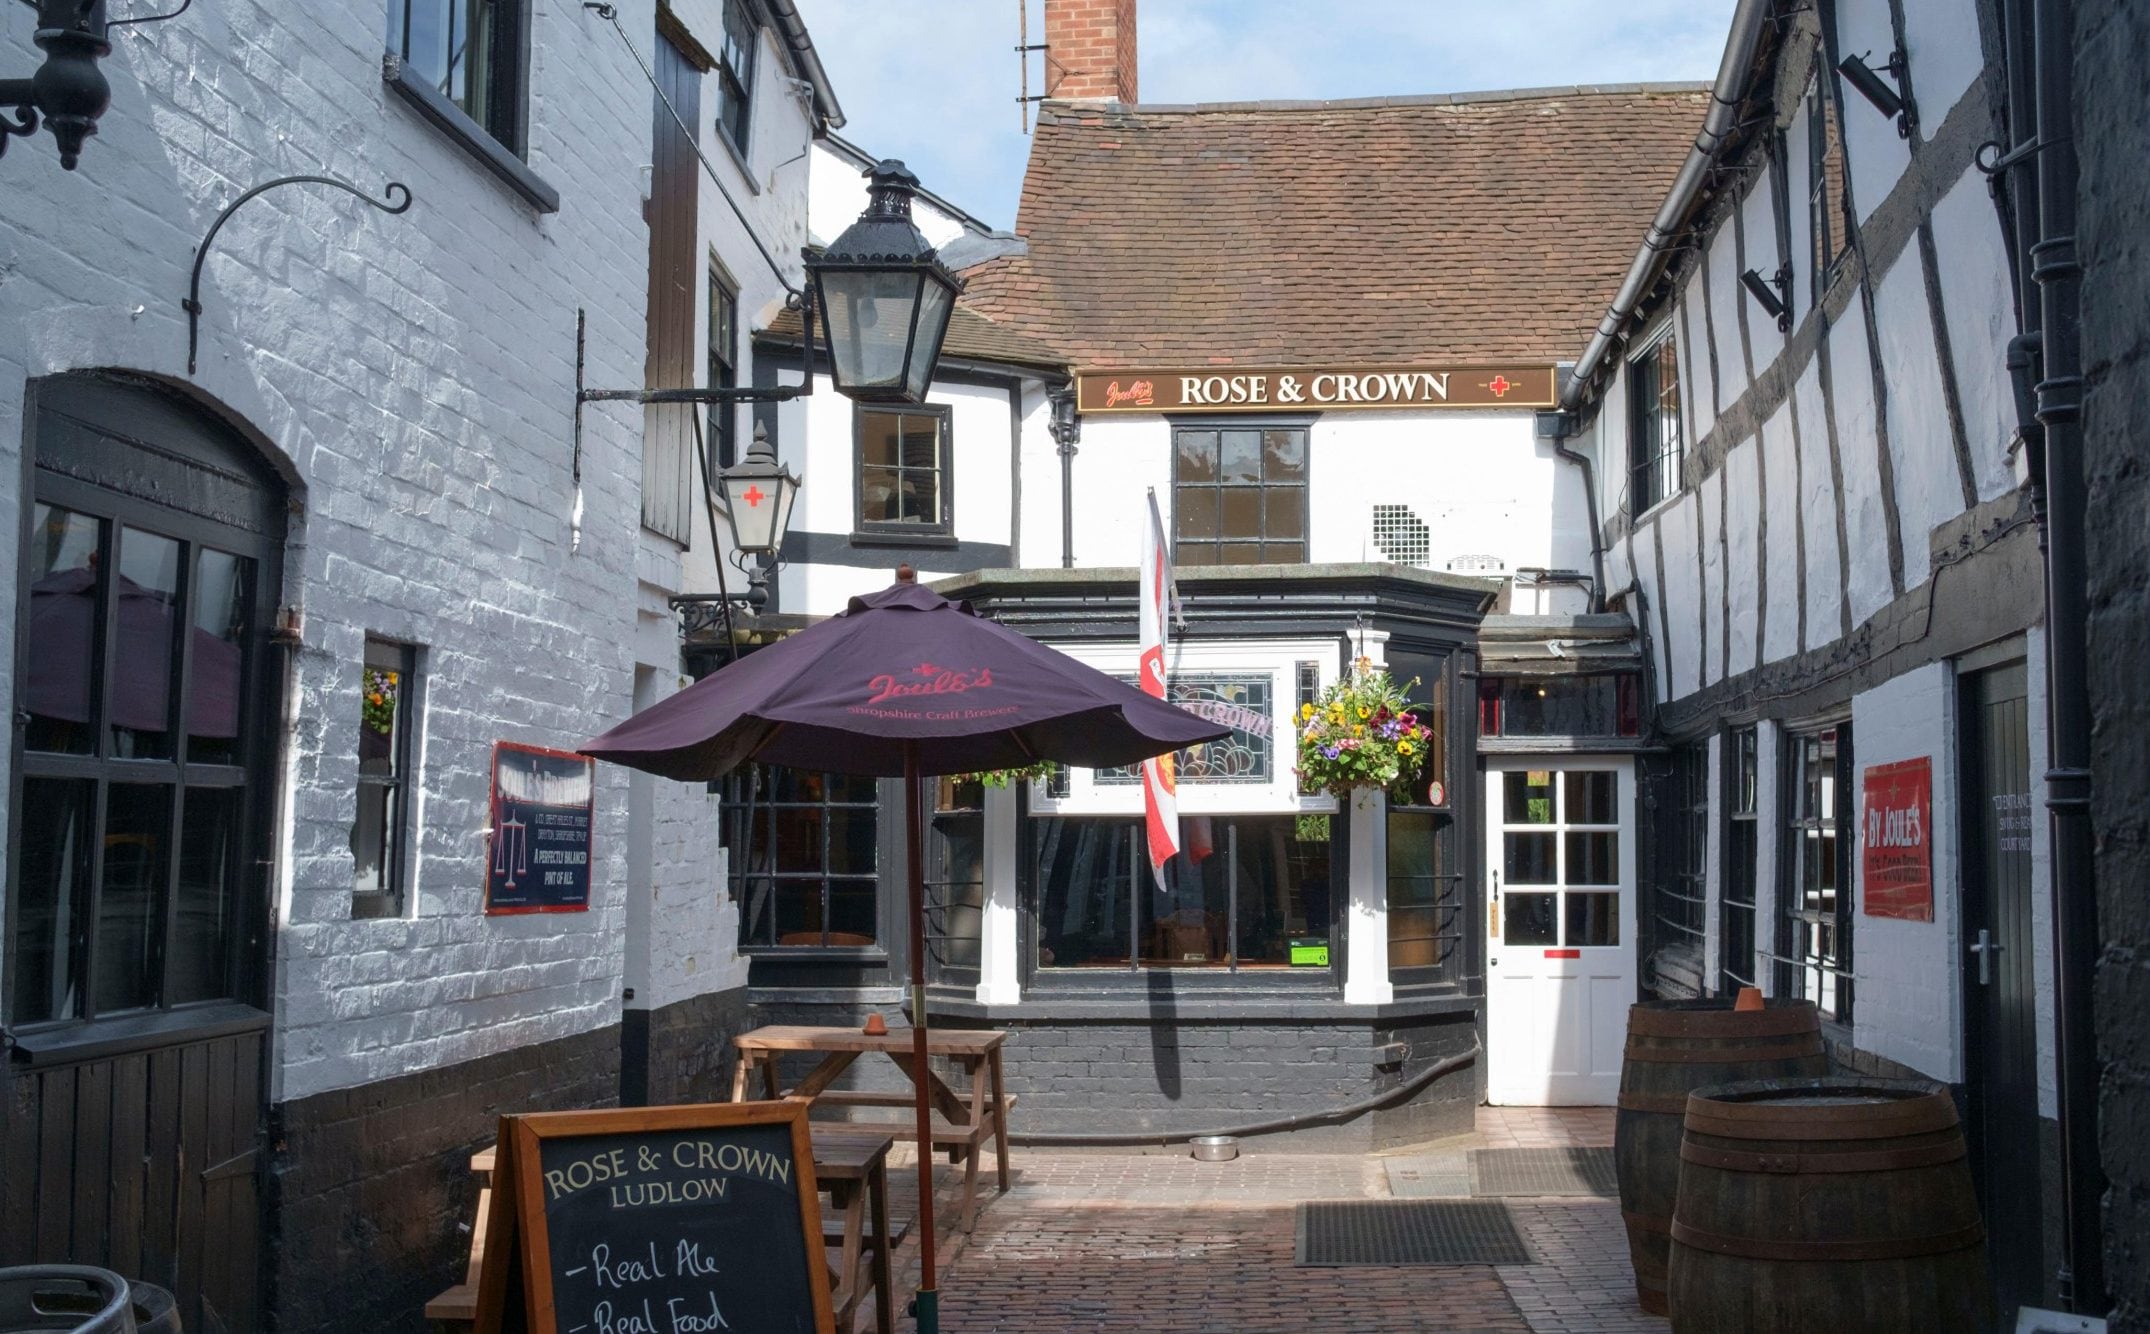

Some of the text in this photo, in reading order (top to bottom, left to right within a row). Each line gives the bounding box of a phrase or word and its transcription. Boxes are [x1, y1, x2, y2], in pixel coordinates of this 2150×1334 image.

[1178, 372, 1451, 404] ROSE & CROWN
[848, 704, 922, 720] Shropshire
[926, 710, 960, 721] Craft
[1200, 701, 1270, 736] CROWN
[1868, 804, 1921, 848] BY JOULE'S
[539, 849, 564, 865] PERFECTLY
[544, 871, 556, 885] PINT
[545, 1142, 791, 1199] ROSE & CROWN
[611, 1177, 727, 1208] LUDLOW
[592, 1243, 666, 1289] Real
[676, 1238, 720, 1277] Ale
[594, 1300, 659, 1334] Real
[667, 1291, 728, 1333] Food
